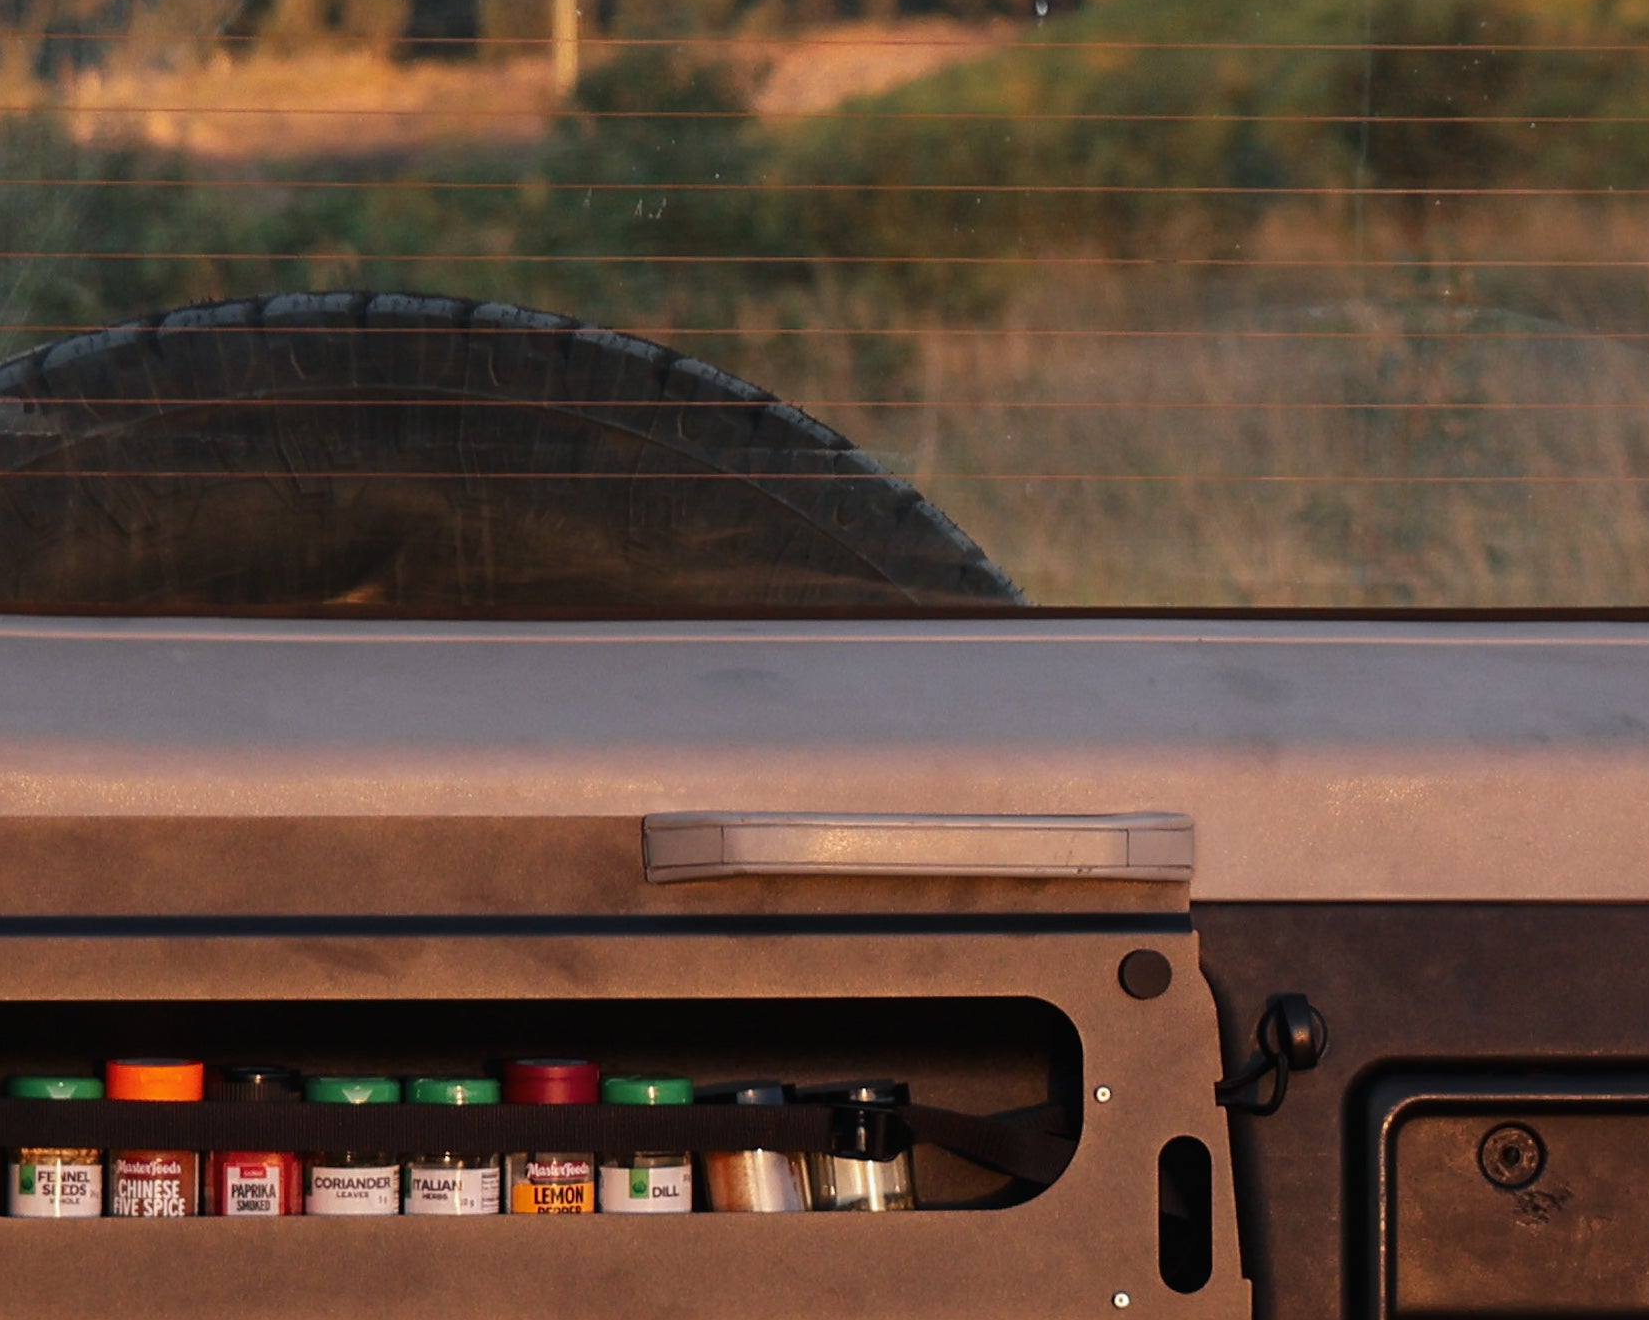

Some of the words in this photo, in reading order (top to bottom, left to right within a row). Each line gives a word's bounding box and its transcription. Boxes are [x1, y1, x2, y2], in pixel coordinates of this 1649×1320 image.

[37, 1170, 91, 1183] FENNEL
[315, 1176, 392, 1190] CORIANDER
[118, 1178, 181, 1198] CHINESE
[231, 1183, 277, 1199] PAPRIKA
[412, 1178, 463, 1191] ITALIAN
[336, 1190, 369, 1199] LEAVES
[534, 1184, 584, 1204] LEMON
[652, 1186, 680, 1198] DILL
[113, 1196, 140, 1217] FIVE
[143, 1197, 186, 1218] SPICE
[236, 1199, 271, 1212] SMOKED
